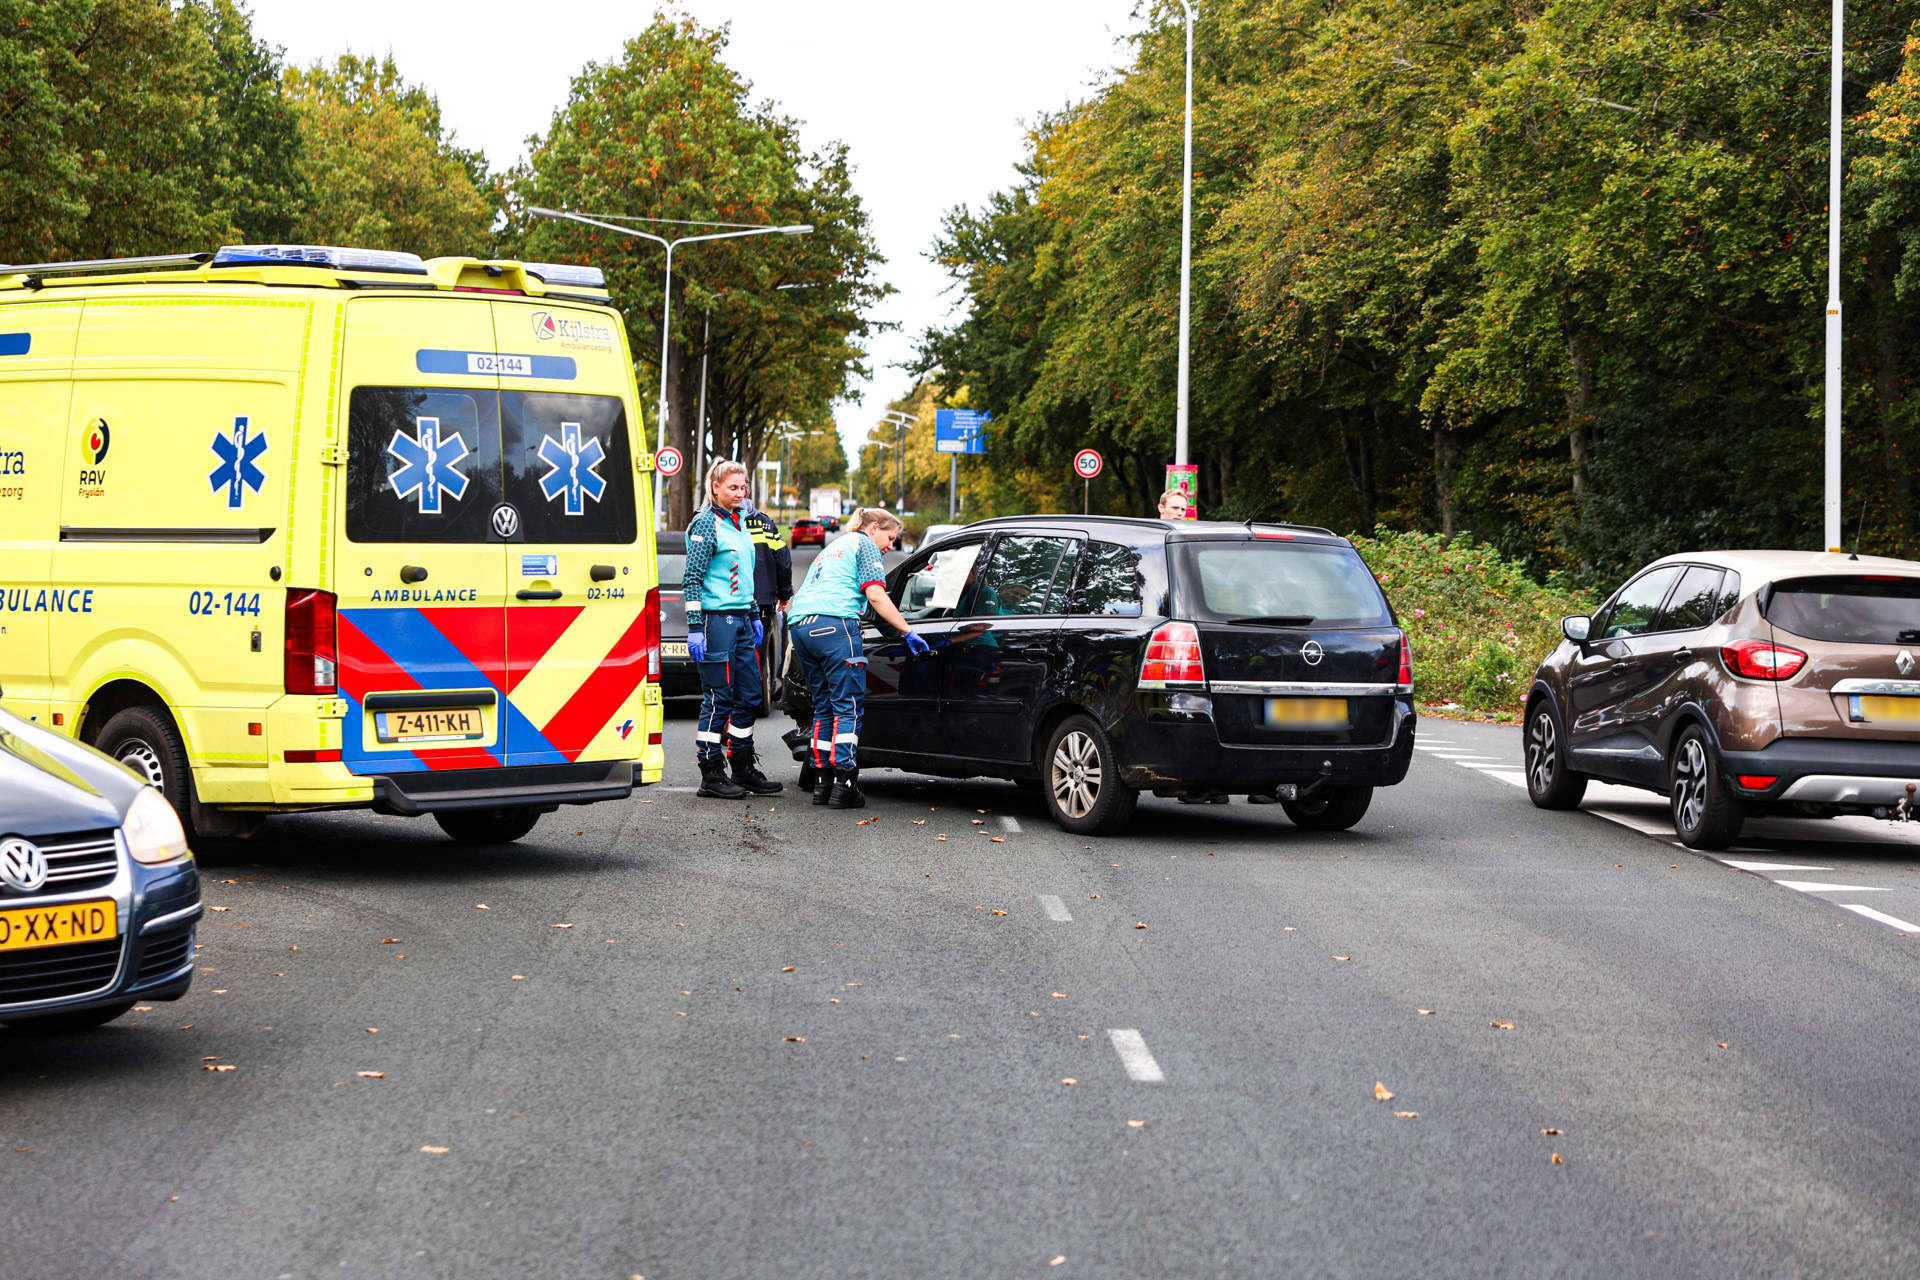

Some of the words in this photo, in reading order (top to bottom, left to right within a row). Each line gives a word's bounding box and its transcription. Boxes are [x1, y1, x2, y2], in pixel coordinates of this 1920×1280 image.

[558, 319, 611, 341] Kijlstra
[477, 357, 523, 372] 02-144
[0, 445, 25, 475] ra
[660, 456, 678, 467] 50
[1079, 458, 1098, 470] 50
[80, 470, 106, 485] RAV
[0, 487, 24, 500] zorg
[370, 588, 478, 602] AMBULANCE
[587, 587, 625, 600] 02-144
[189, 591, 261, 617] 02-144
[396, 713, 471, 734] Z-411-KH
